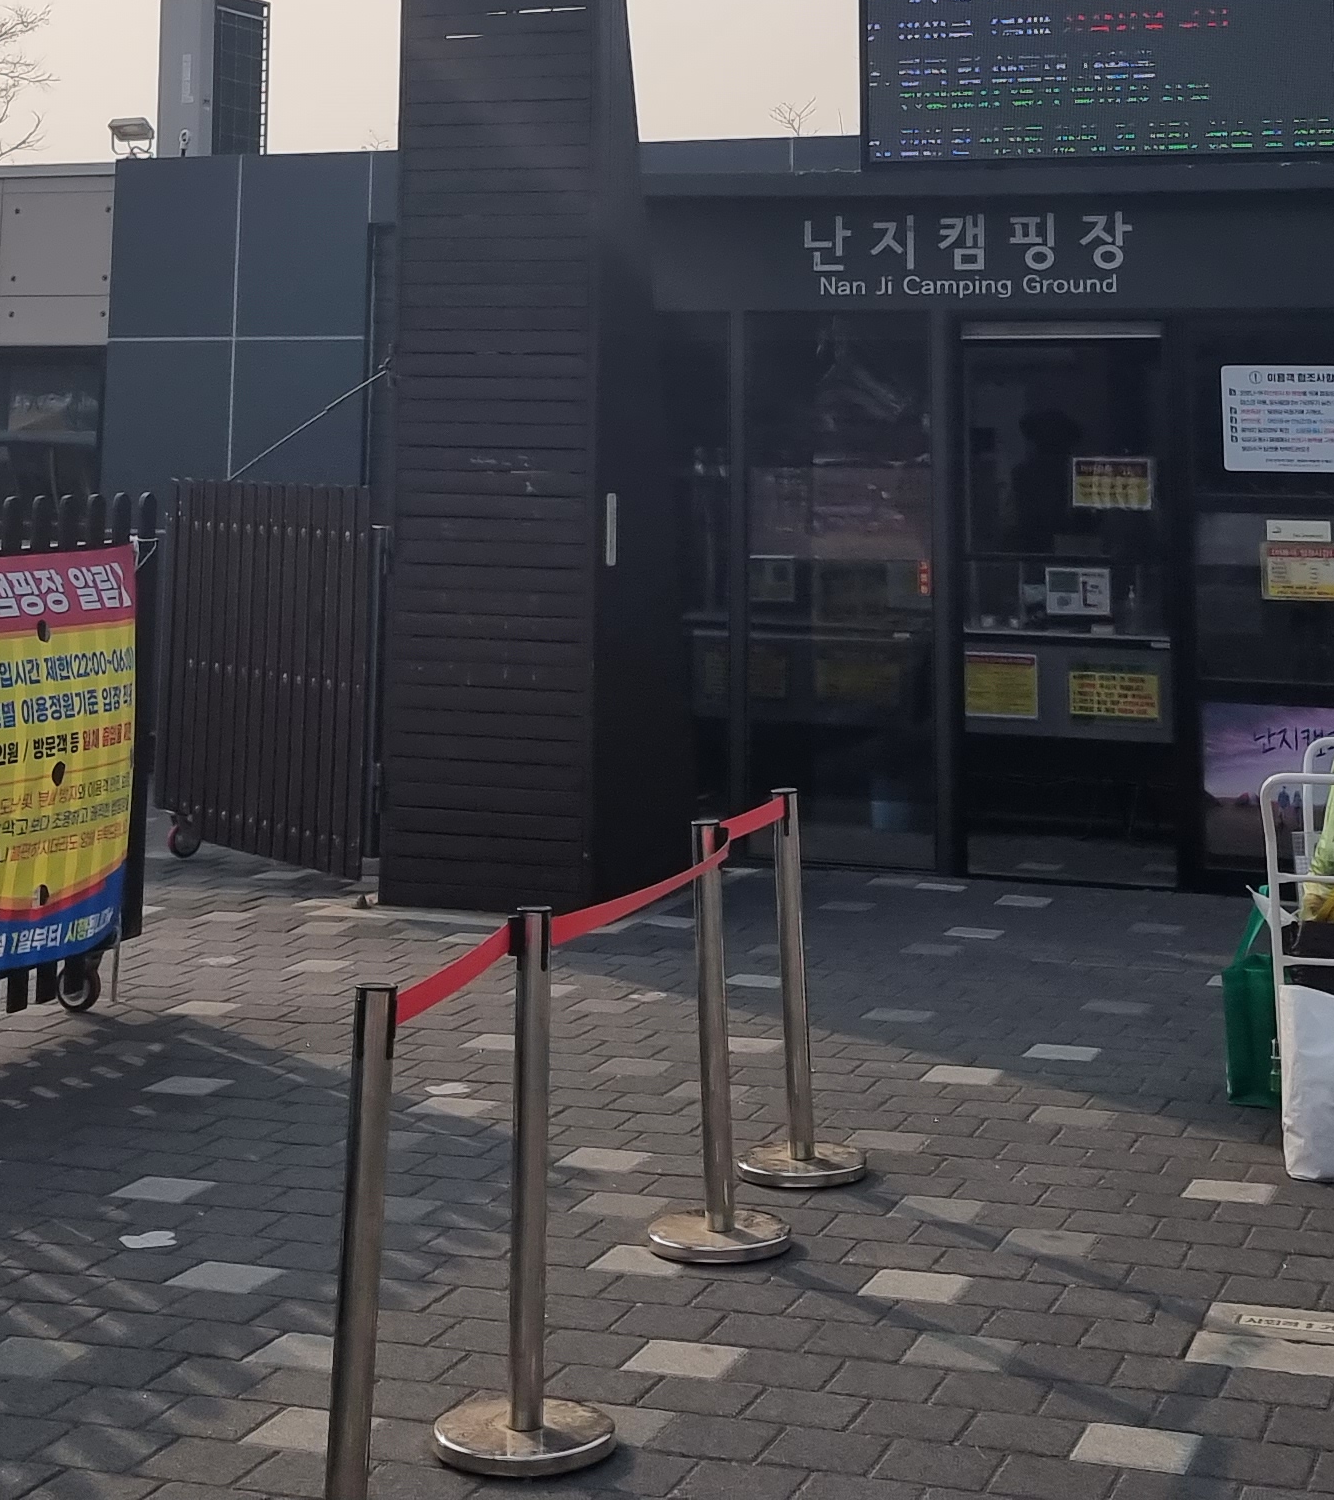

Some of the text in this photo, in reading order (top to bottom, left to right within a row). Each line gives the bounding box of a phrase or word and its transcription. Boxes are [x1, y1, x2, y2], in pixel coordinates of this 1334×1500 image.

[803, 210, 1134, 273] 난지캠핑장
[819, 273, 1118, 299] Nan Ji Camping Ground
[21, 689, 99, 725] 이용정원기준
[33, 733, 67, 761] 방문객
[9, 923, 63, 955] 1일부터
